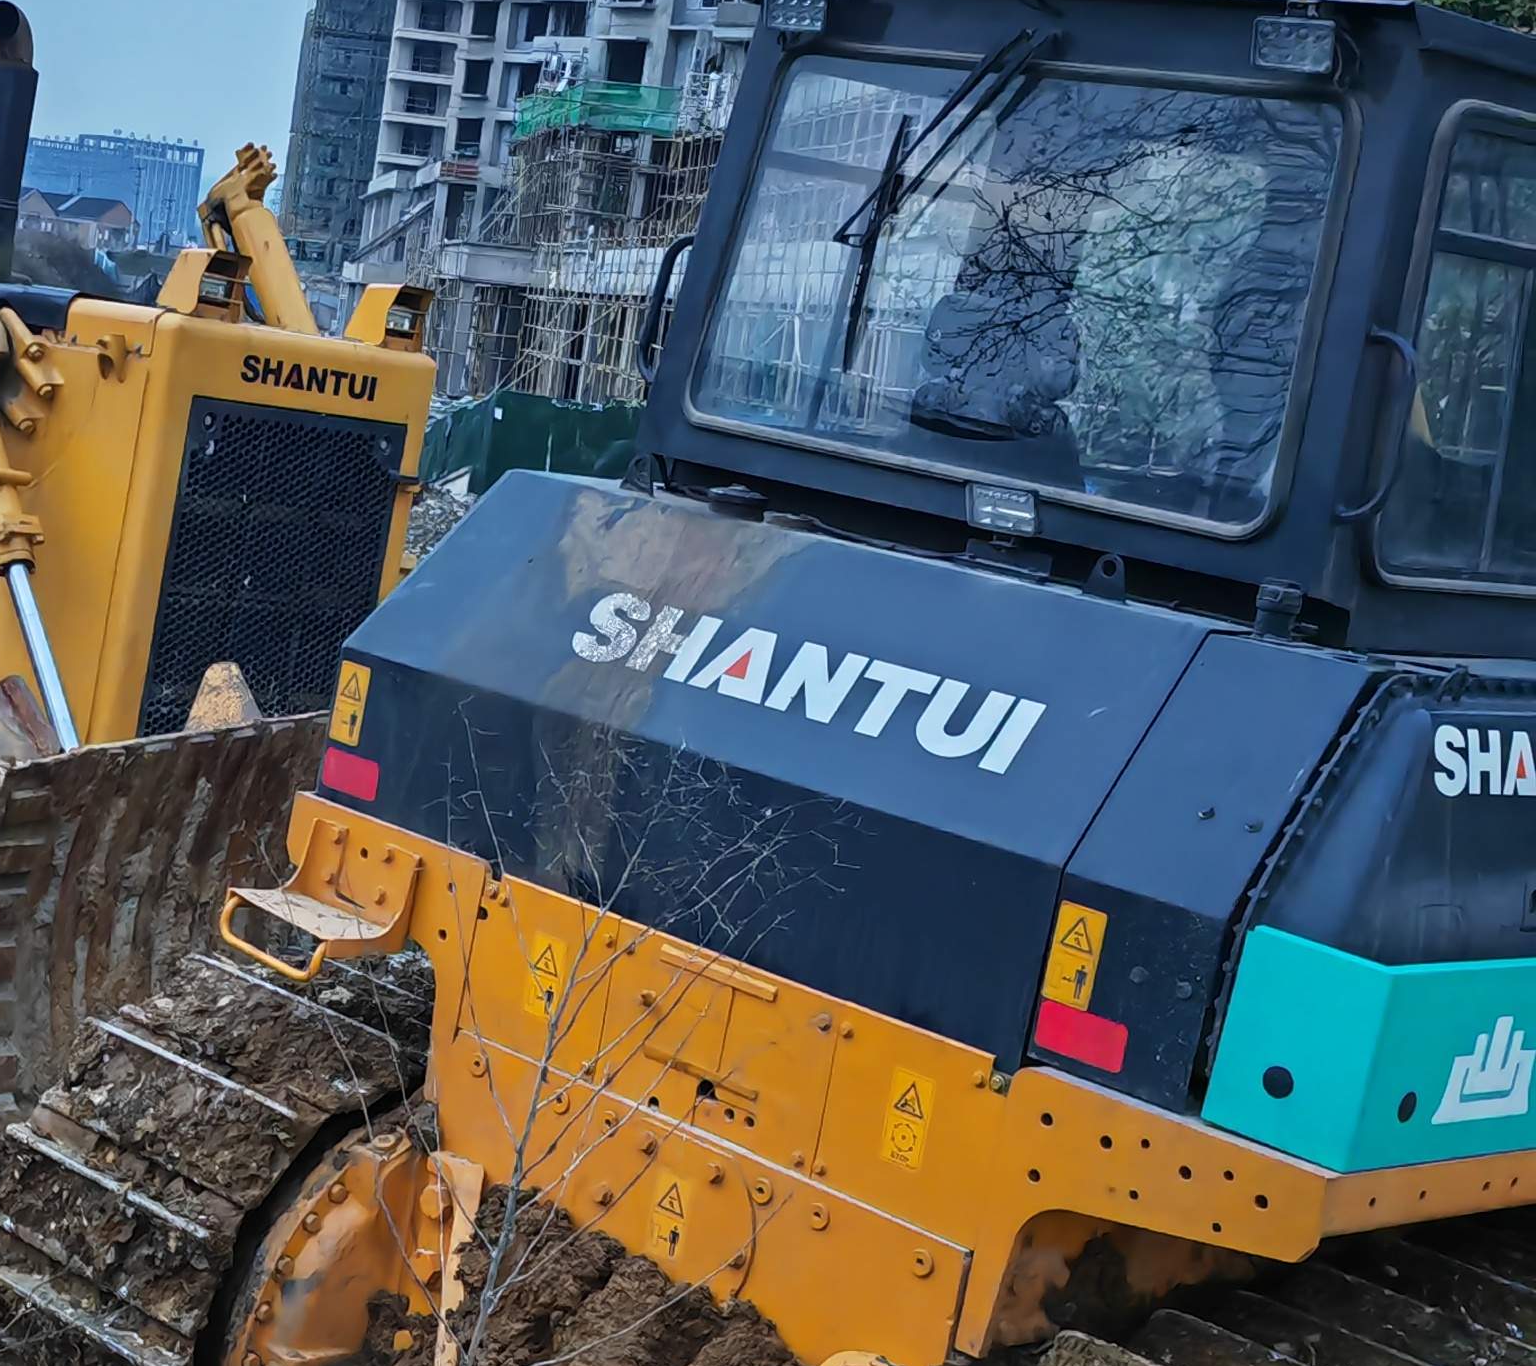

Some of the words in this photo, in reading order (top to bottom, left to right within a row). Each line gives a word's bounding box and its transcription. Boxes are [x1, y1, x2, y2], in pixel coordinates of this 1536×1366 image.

[240, 354, 378, 402] SHANTUI
[571, 592, 1047, 775] SHANTUI
[1434, 724, 1536, 797] SHA
